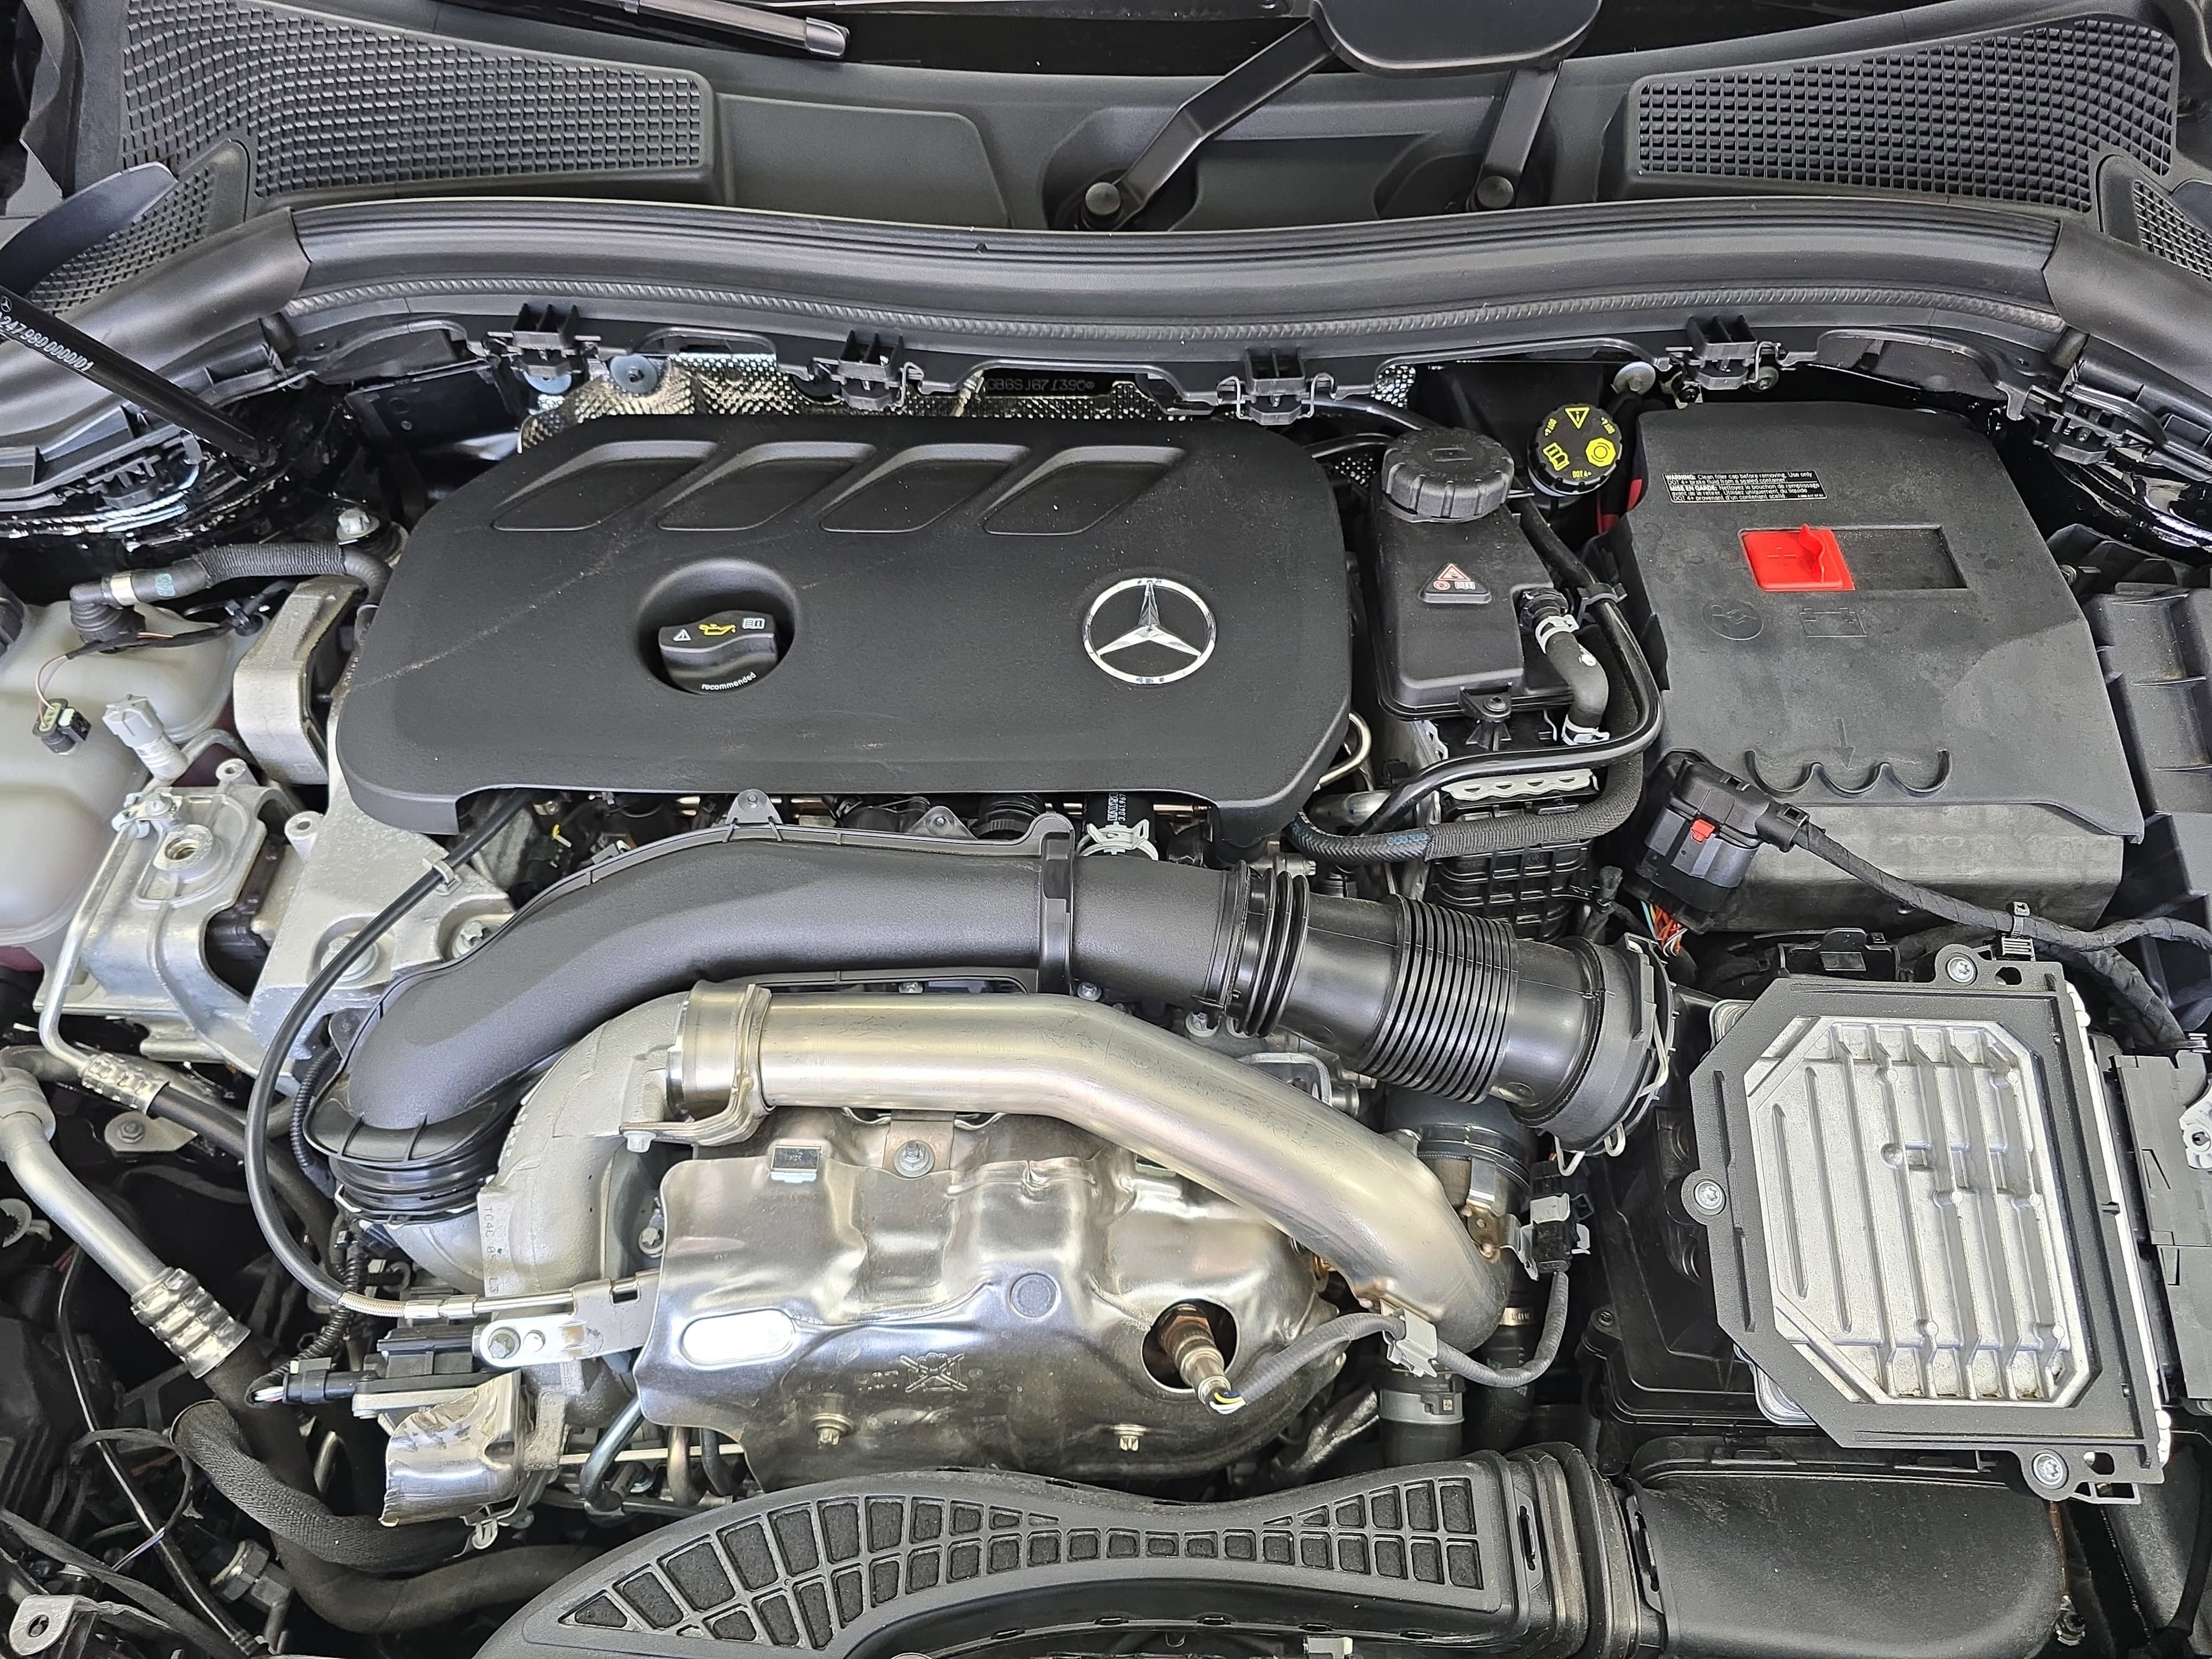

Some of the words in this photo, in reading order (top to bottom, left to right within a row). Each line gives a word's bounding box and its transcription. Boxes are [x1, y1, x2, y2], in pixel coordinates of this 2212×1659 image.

[0, 312, 28, 335] 247
[20, 329, 49, 348] 980
[1547, 419, 1557, 430] DOT
[1604, 423, 1616, 434] DOT
[702, 672, 757, 690] recommended
